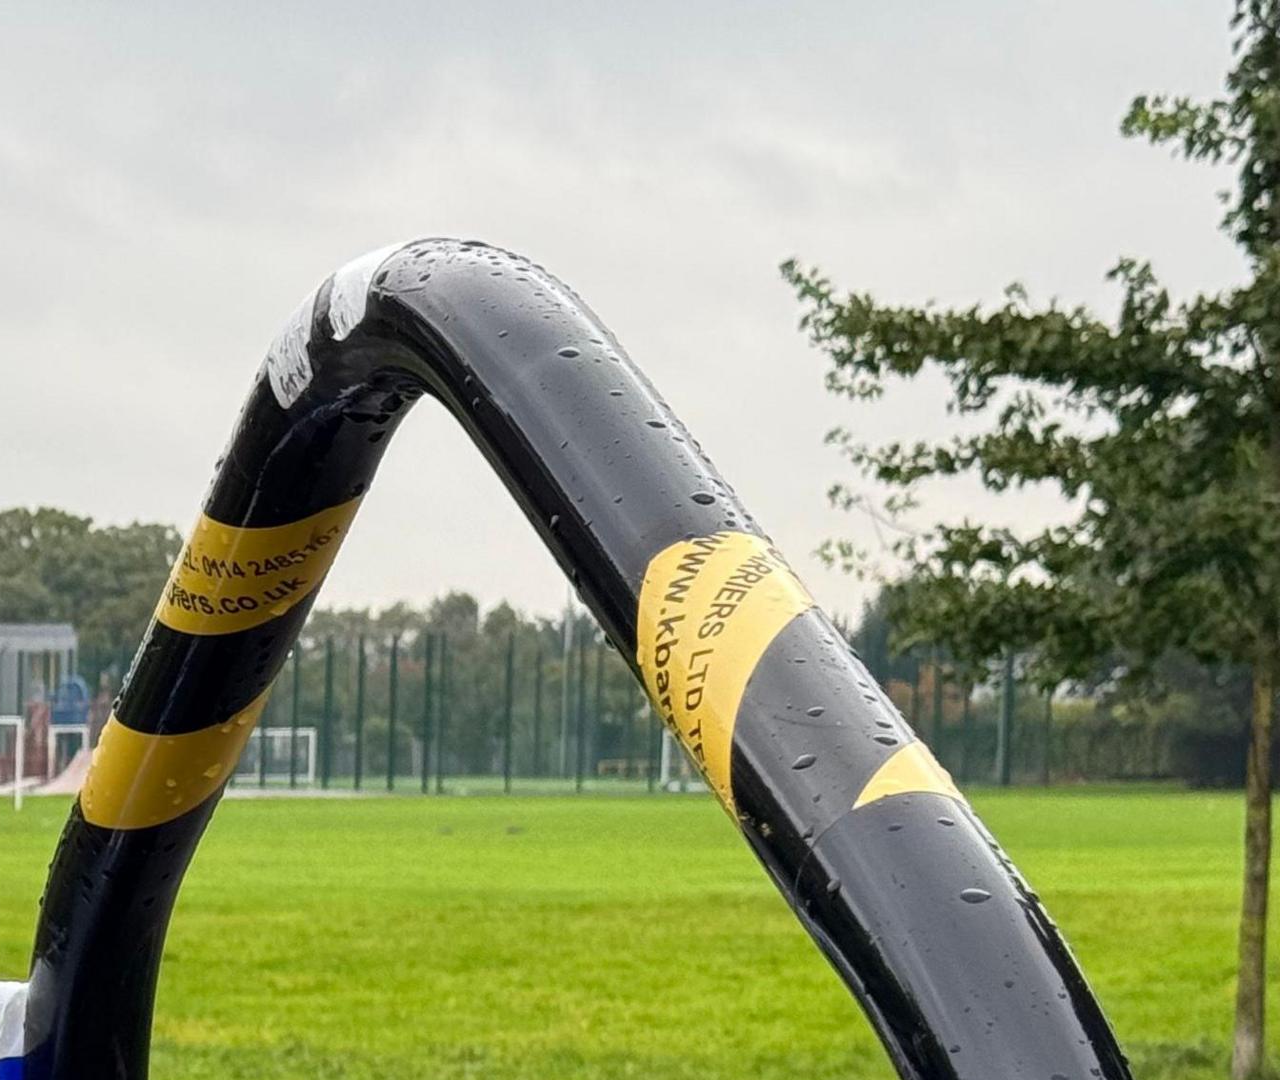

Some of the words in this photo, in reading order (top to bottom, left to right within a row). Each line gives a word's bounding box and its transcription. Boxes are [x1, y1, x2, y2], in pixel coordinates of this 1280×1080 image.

[202, 555, 245, 579] 0114
[248, 524, 340, 577] 2485107
[697, 548, 778, 640] ARRIERS
[685, 647, 715, 712] LTD
